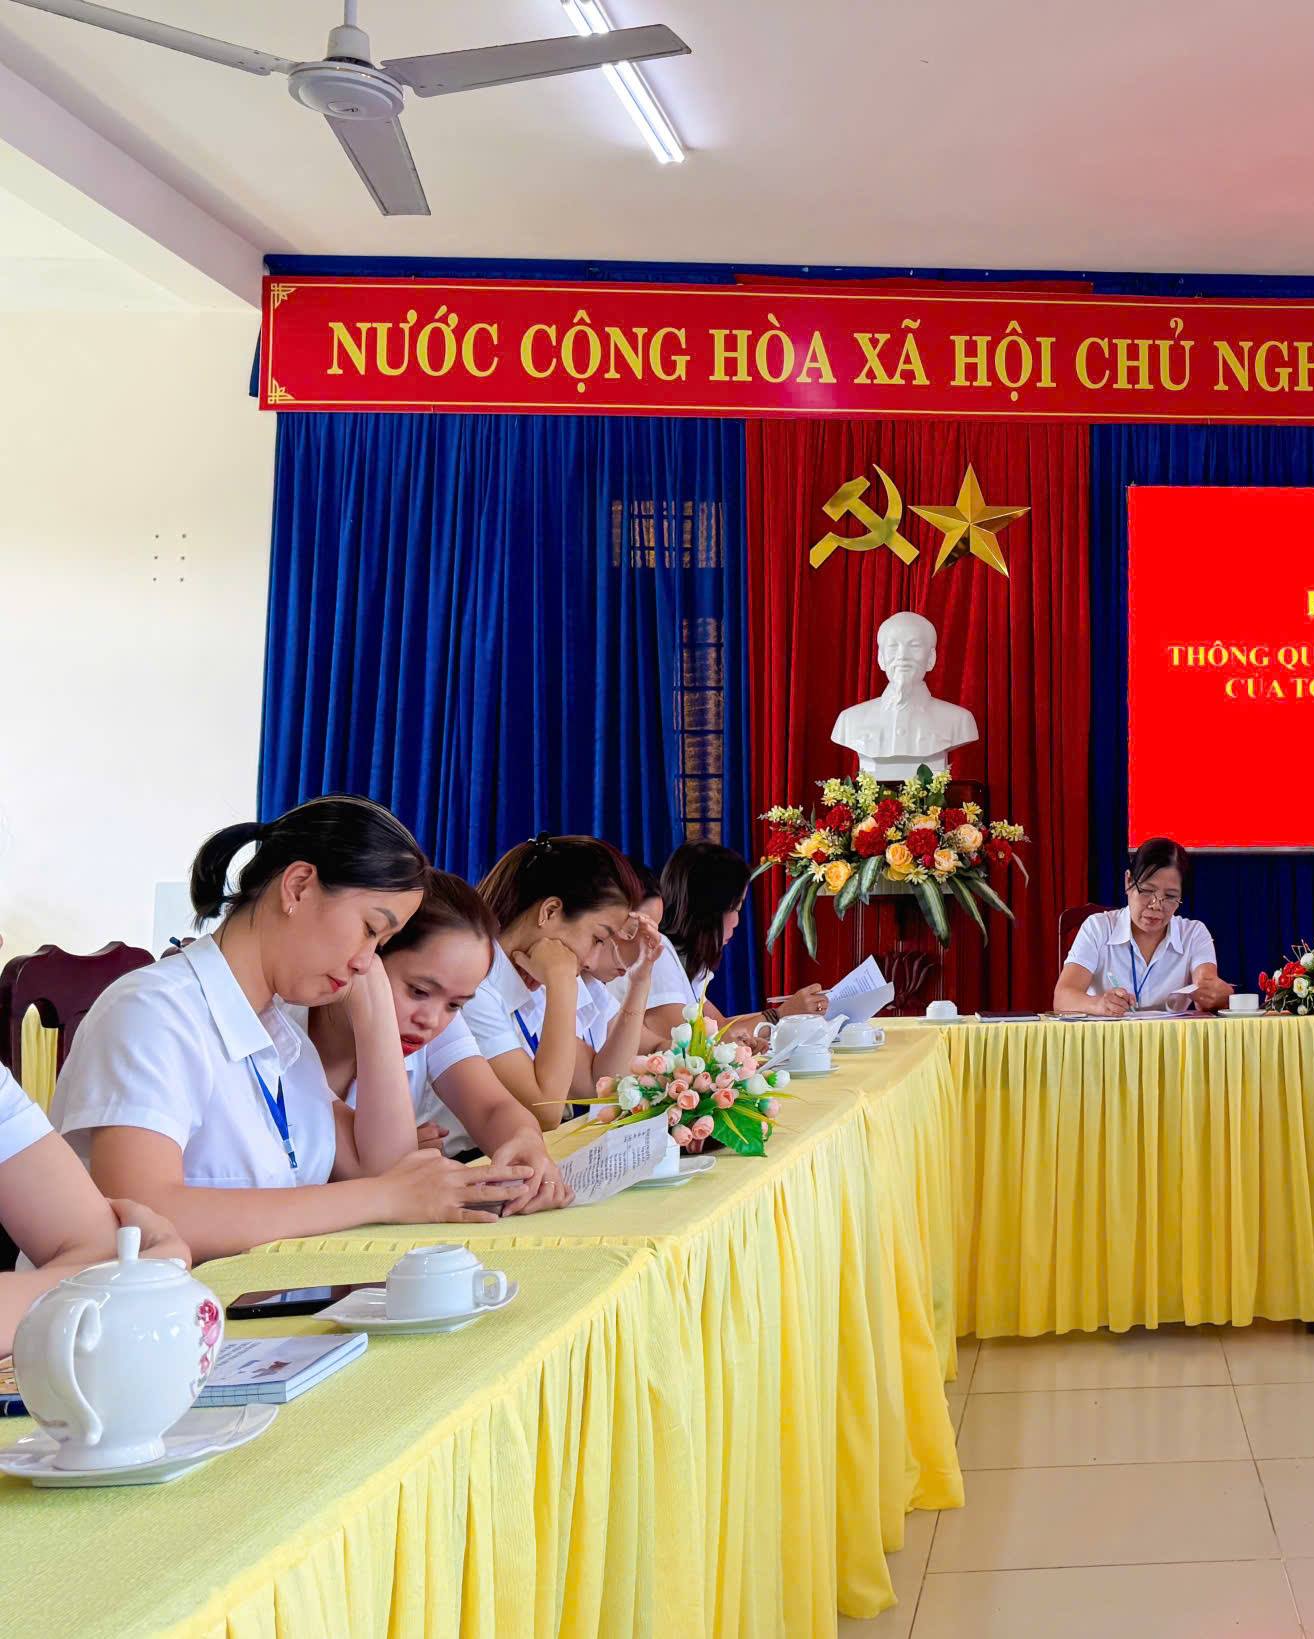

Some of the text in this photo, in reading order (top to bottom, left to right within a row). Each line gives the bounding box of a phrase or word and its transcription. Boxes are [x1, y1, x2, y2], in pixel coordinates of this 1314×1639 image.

[327, 309, 499, 378] NƯỚC
[520, 309, 690, 394] CỘNG
[710, 313, 837, 384] HÒA
[852, 319, 930, 386] XÃ
[950, 319, 1057, 402] HỘI
[1075, 317, 1195, 392] CHỦ
[1167, 640, 1270, 666] THÔNG
